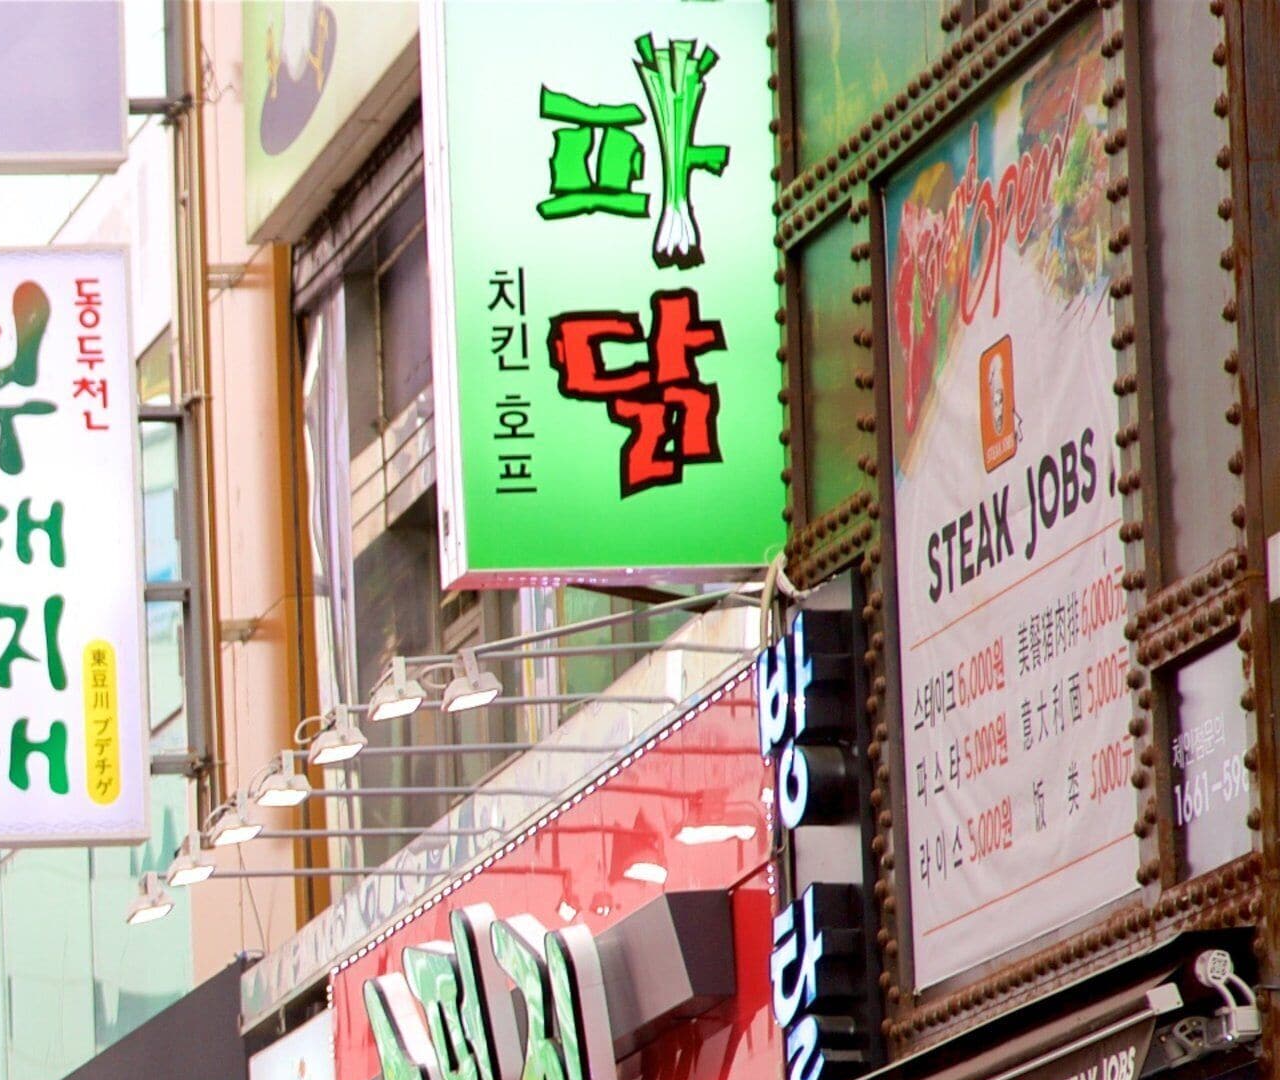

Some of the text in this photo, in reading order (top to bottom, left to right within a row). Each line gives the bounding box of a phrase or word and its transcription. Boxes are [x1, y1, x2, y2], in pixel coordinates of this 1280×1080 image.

[72, 278, 109, 431] 동두천
[536, 33, 731, 500] 파닭
[487, 267, 538, 494] 치킨 호프
[927, 427, 1095, 604] STEAK JOBS
[914, 668, 957, 731] 스테이크
